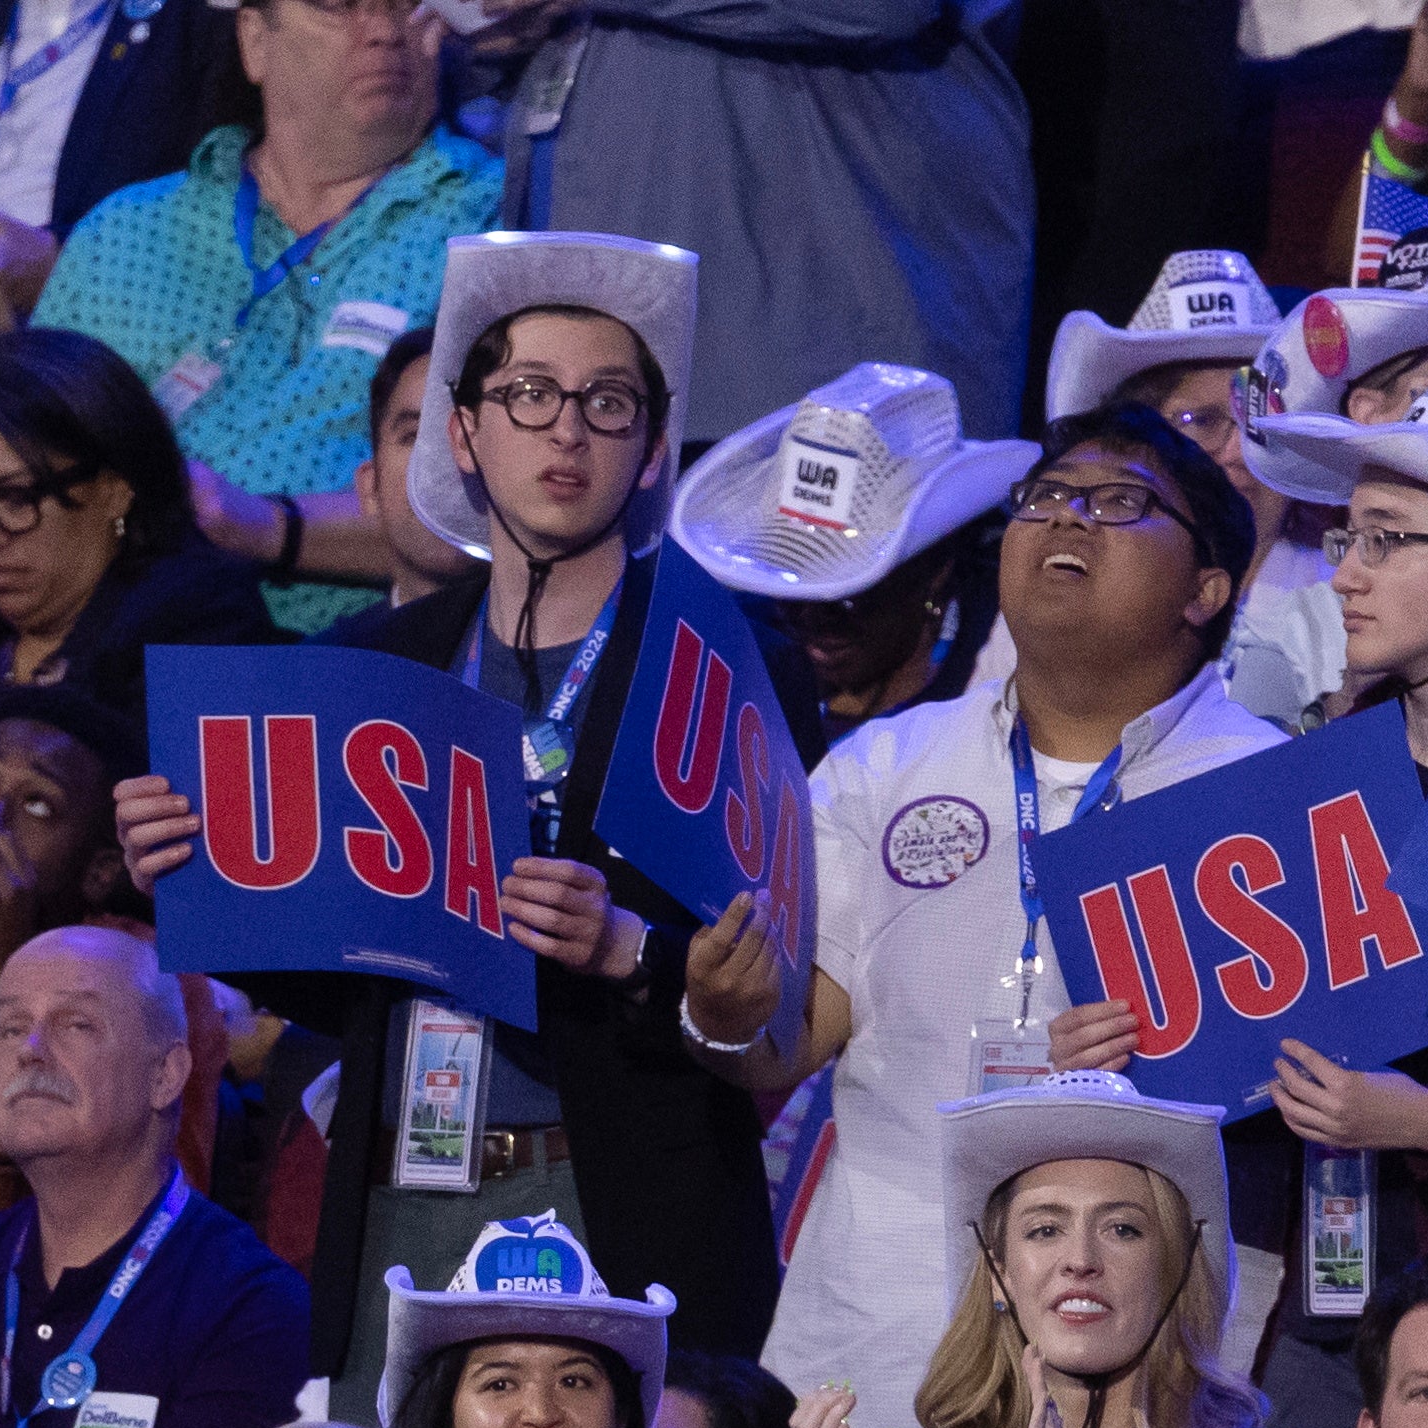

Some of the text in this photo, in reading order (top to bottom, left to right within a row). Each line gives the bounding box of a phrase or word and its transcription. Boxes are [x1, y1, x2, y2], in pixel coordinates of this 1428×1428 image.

[1187, 293, 1235, 313] WA
[797, 460, 839, 491] WA
[547, 628, 609, 721] DNC 2024
[199, 714, 504, 939] USA
[1019, 792, 1036, 830] DNC
[1080, 790, 1423, 1060] USA
[109, 1257, 143, 1299] DNC
[497, 1246, 562, 1279] WA
[497, 1278, 563, 1293] DEMS
